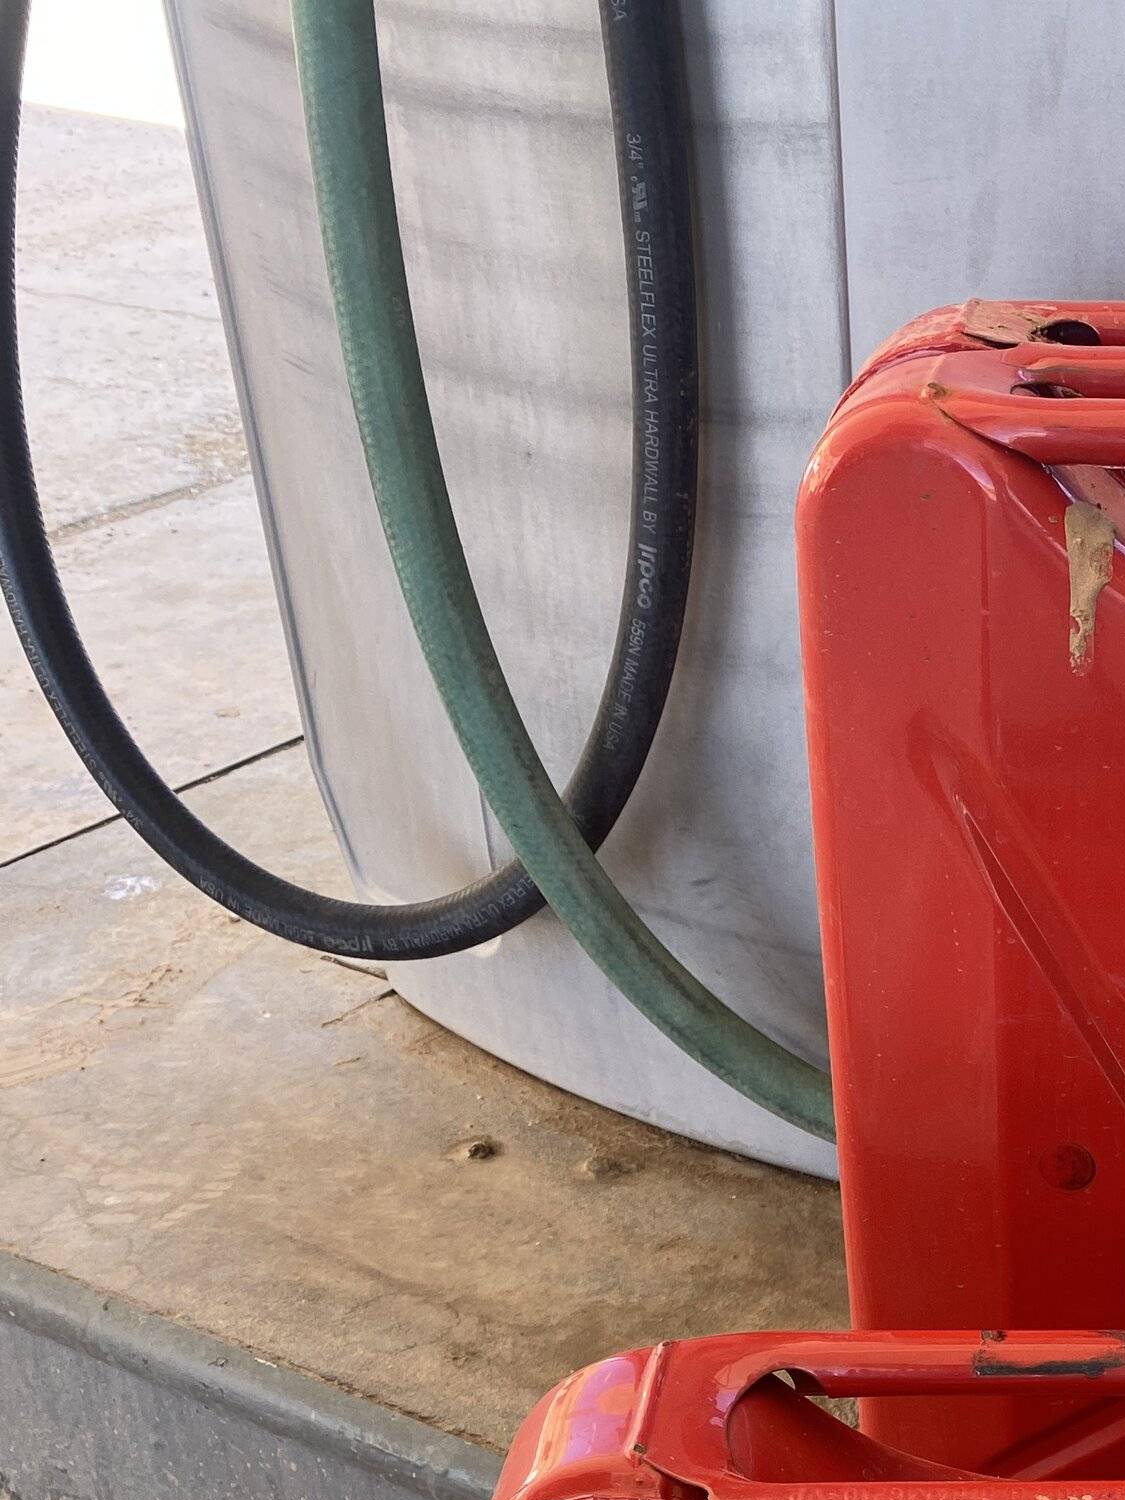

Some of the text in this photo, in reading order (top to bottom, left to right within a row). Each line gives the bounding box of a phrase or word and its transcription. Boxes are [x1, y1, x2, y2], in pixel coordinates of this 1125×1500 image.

[635, 230, 656, 338] STEELFLEX
[641, 344, 658, 404] ULTRA
[643, 410, 660, 505] HARDWALL
[642, 510, 657, 535] BY
[617, 657, 640, 703] MADE
[613, 702, 628, 720] IN
[603, 721, 623, 750] USA
